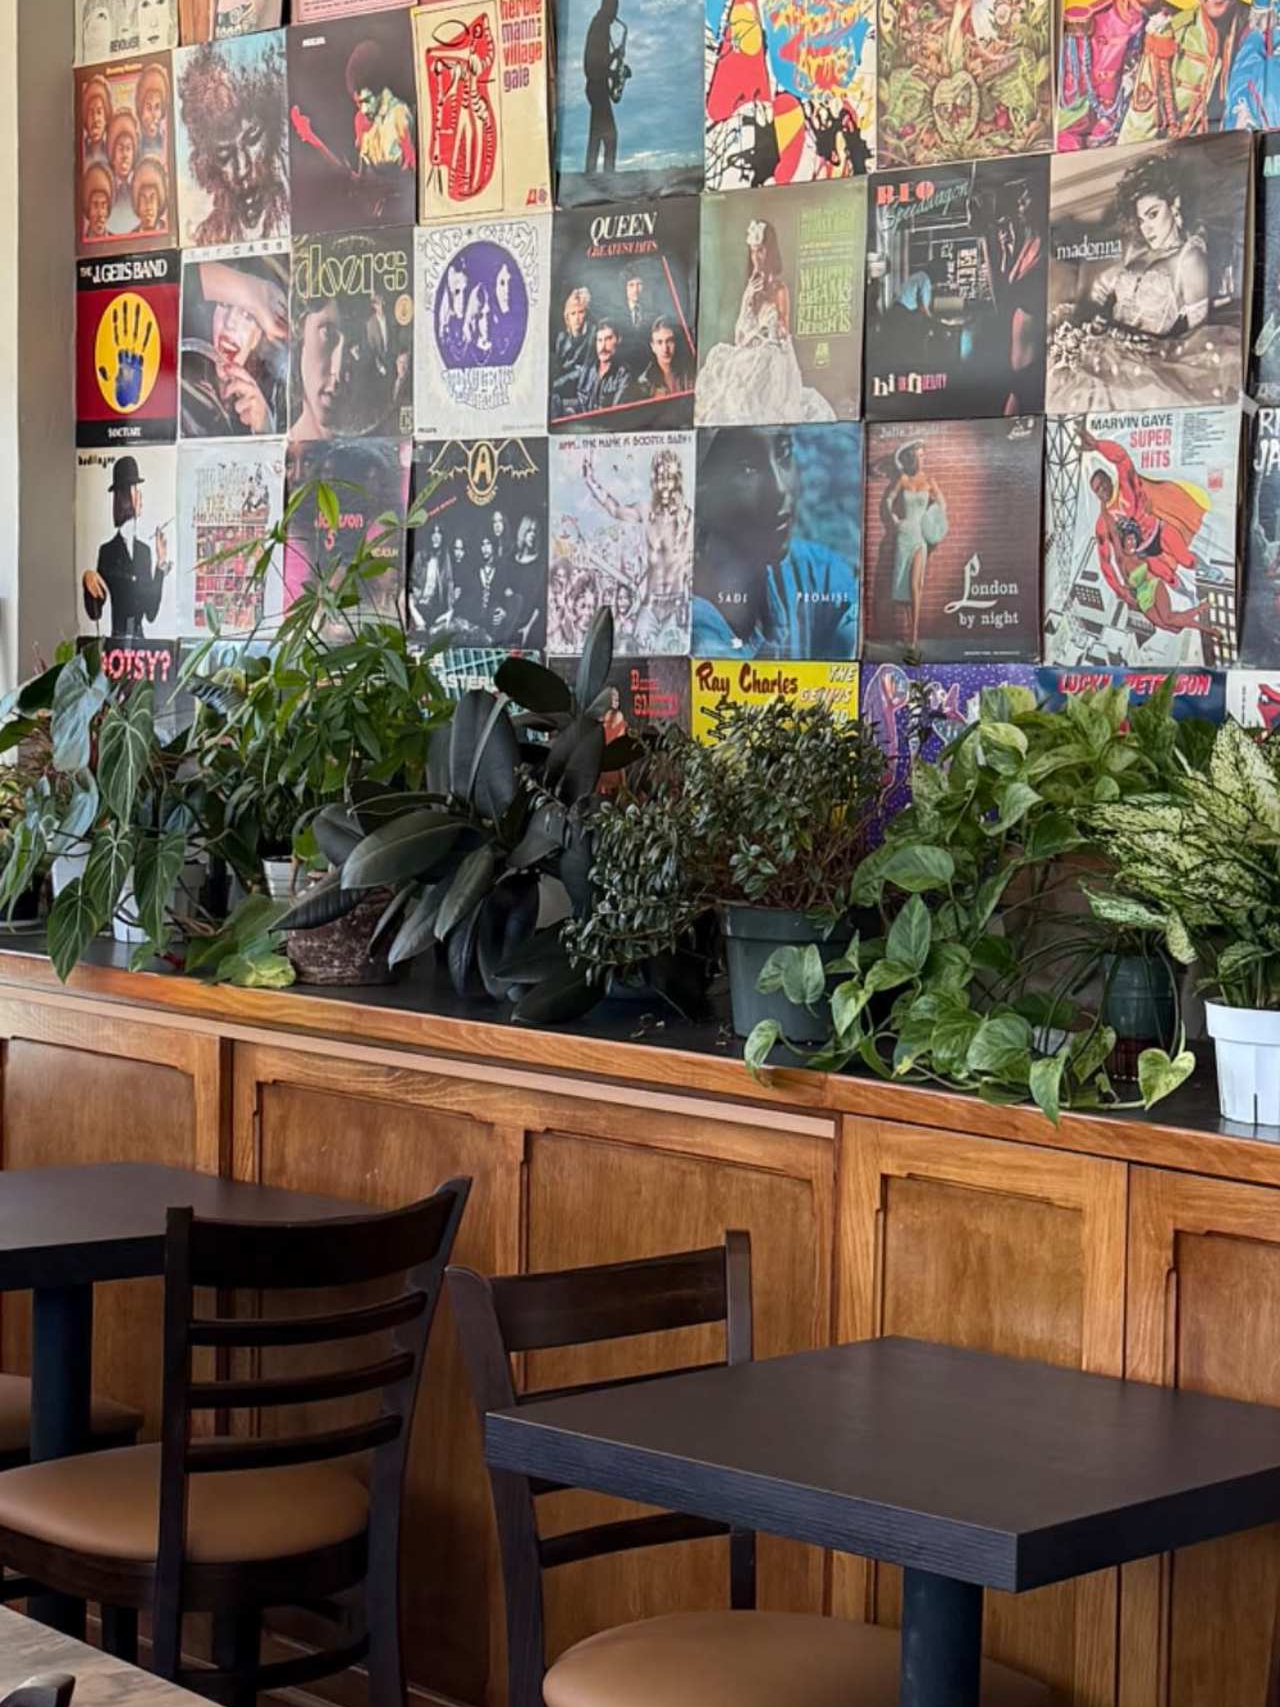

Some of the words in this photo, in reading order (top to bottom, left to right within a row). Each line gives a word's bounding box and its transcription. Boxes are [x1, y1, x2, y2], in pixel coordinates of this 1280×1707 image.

[502, 40, 543, 67] village
[590, 211, 658, 246] QUEEN
[1056, 233, 1122, 261] madonna
[133, 258, 168, 280] BAND
[295, 243, 409, 300] doors
[1090, 415, 1139, 432] MARVIN
[1140, 413, 1174, 428] GAYE
[1129, 428, 1172, 449] SUPER
[1140, 448, 1171, 470] HITS
[943, 553, 1019, 615] London
[959, 612, 976, 630] by
[980, 609, 1020, 630] night
[101, 646, 172, 682] OTSY?
[829, 665, 857, 684] THE
[695, 661, 730, 694] Ray
[738, 663, 799, 695] Charles
